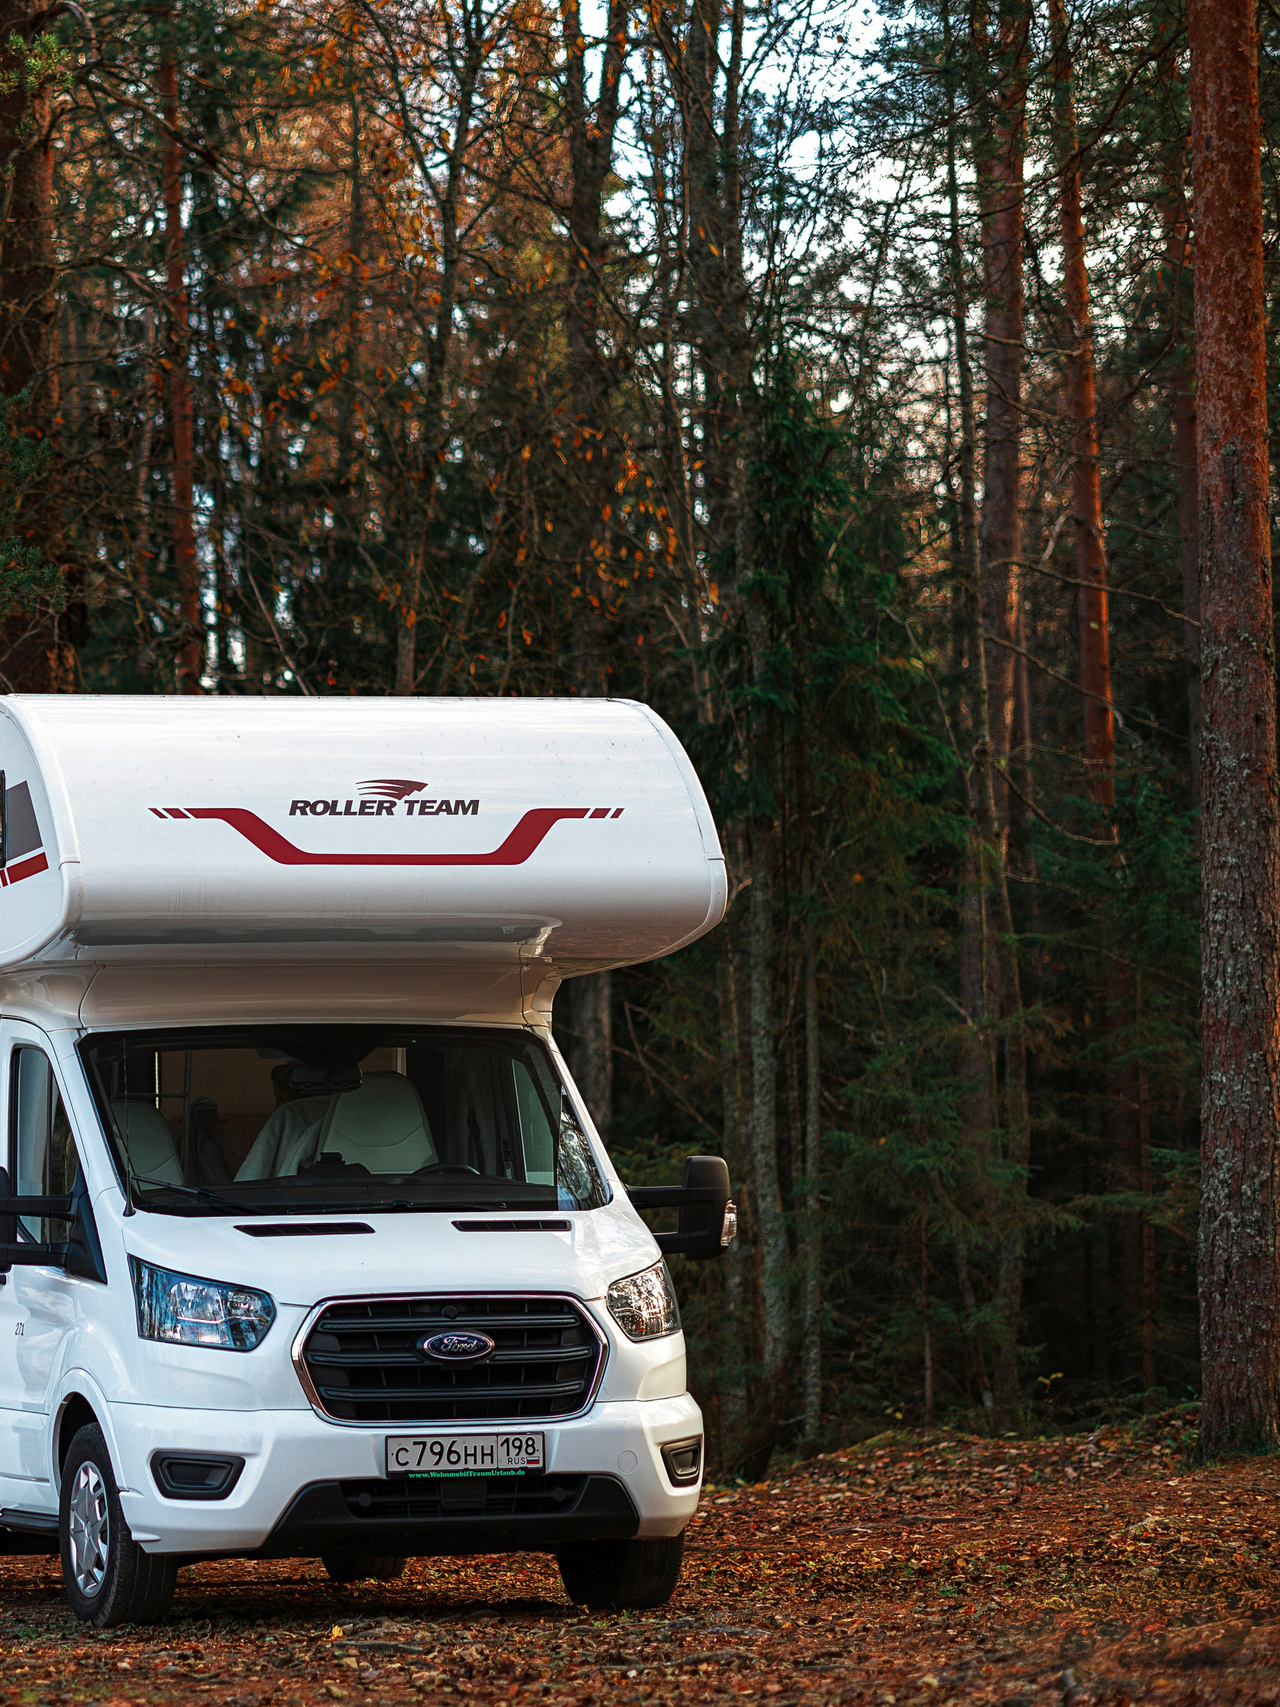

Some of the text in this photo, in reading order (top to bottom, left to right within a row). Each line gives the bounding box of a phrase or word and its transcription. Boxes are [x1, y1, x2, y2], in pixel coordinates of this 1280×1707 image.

[289, 800, 479, 816] ROLLER TEAM
[15, 1322, 24, 1336] 271
[441, 1336, 477, 1352] Ford
[395, 1437, 536, 1467] C796HH 198
[507, 1457, 526, 1465] RUS
